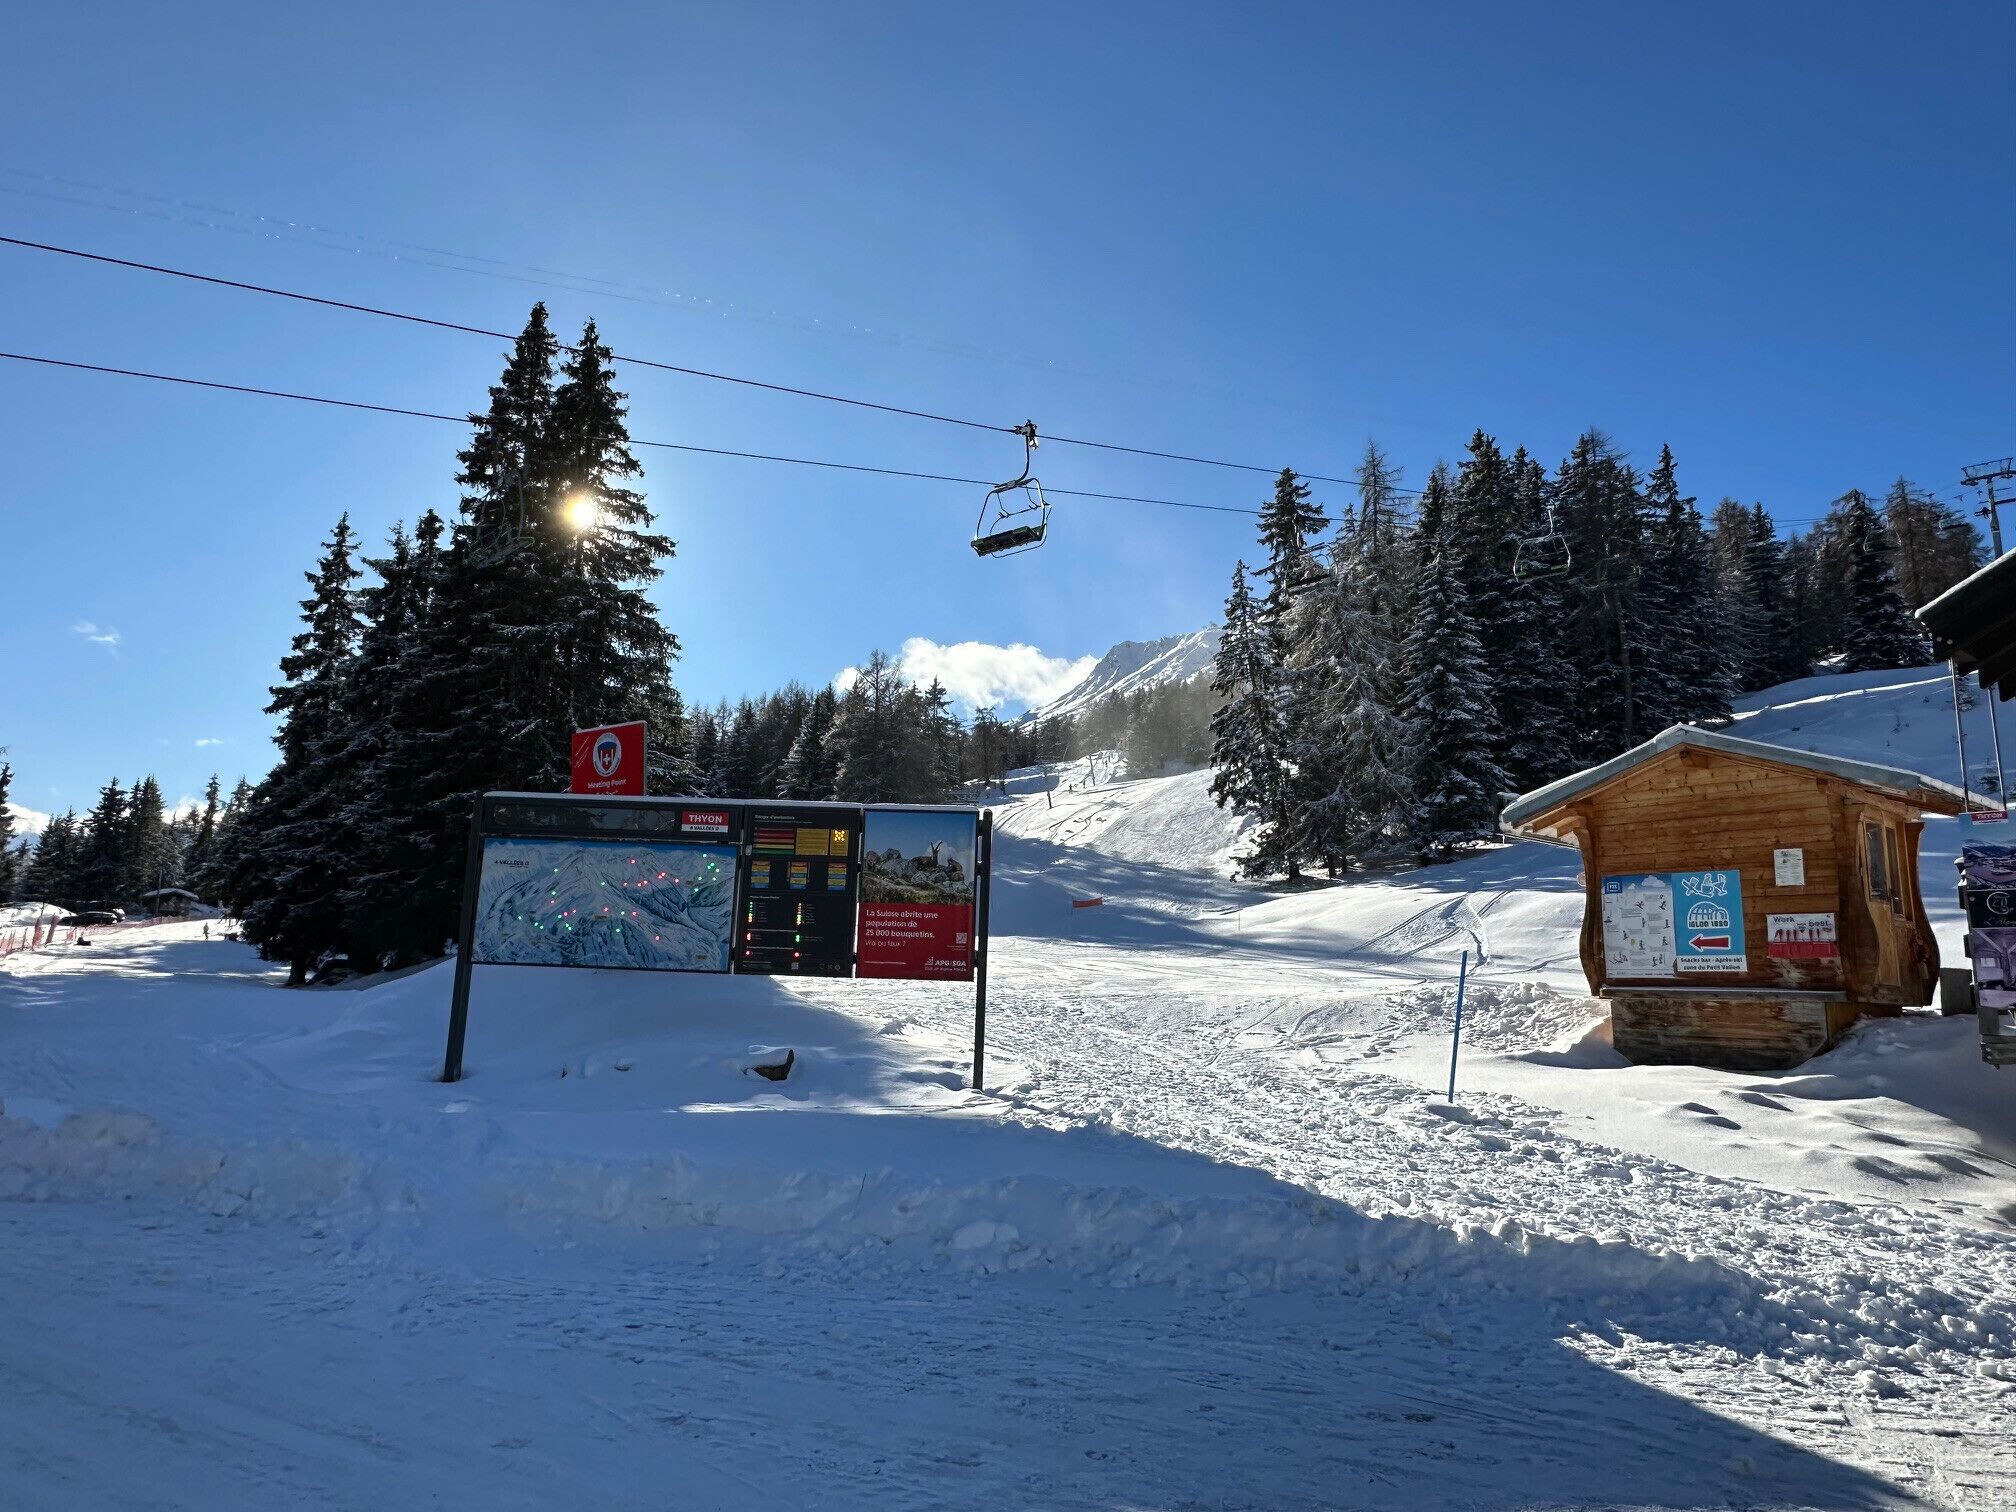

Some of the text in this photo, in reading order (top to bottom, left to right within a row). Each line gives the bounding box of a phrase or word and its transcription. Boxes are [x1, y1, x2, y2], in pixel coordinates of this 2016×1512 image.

[587, 778, 627, 789] Meeting Point
[688, 814, 723, 824] THYON
[876, 909, 899, 918] Suisse
[900, 910, 923, 918] abrite
[865, 920, 907, 928] population
[875, 929, 890, 937] 000
[890, 930, 936, 939] bouquetins.
